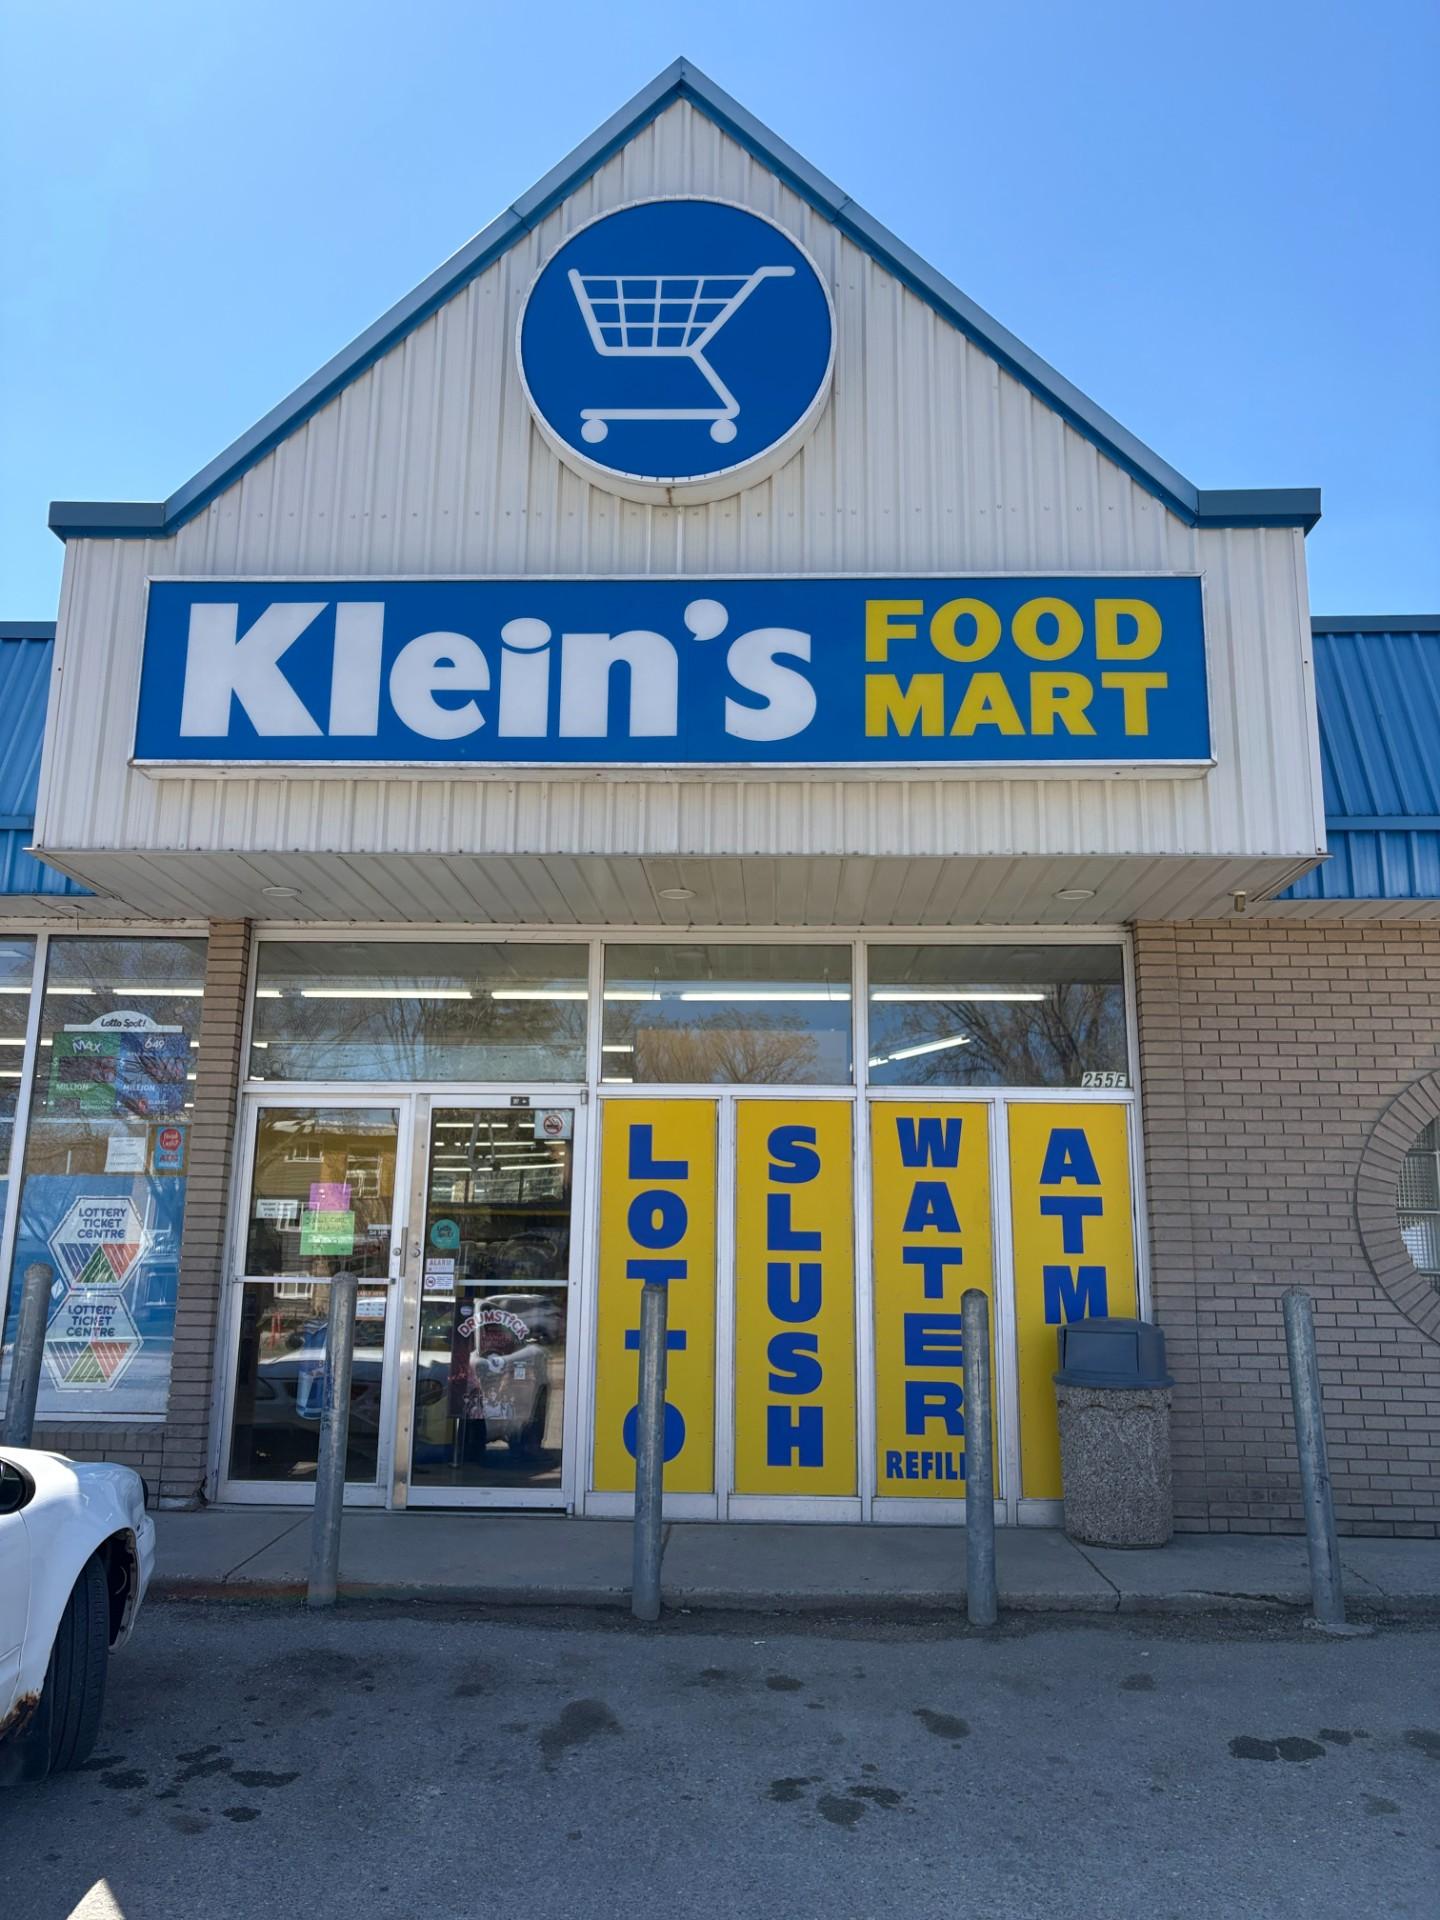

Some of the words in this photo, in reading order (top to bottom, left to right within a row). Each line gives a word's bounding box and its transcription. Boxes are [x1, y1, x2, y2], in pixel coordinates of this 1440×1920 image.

[864, 597, 1163, 662] FOOD
[180, 599, 817, 742] Klein's
[864, 671, 1168, 737] MART
[101, 1018, 122, 1028] Lotto
[56, 1083, 89, 1092] MILLION
[122, 1084, 155, 1092] MILLION
[79, 1207, 127, 1218] LOTTERY
[83, 1218, 122, 1228] TICKET
[1039, 1128, 1108, 1324] ATM
[77, 1228, 126, 1239] CENTRE
[896, 1117, 964, 1436] WATER
[766, 1125, 823, 1468] SLUSH
[68, 1305, 117, 1315] LOTTERY
[72, 1315, 112, 1326] TICKET
[66, 1326, 116, 1337] CENTRE
